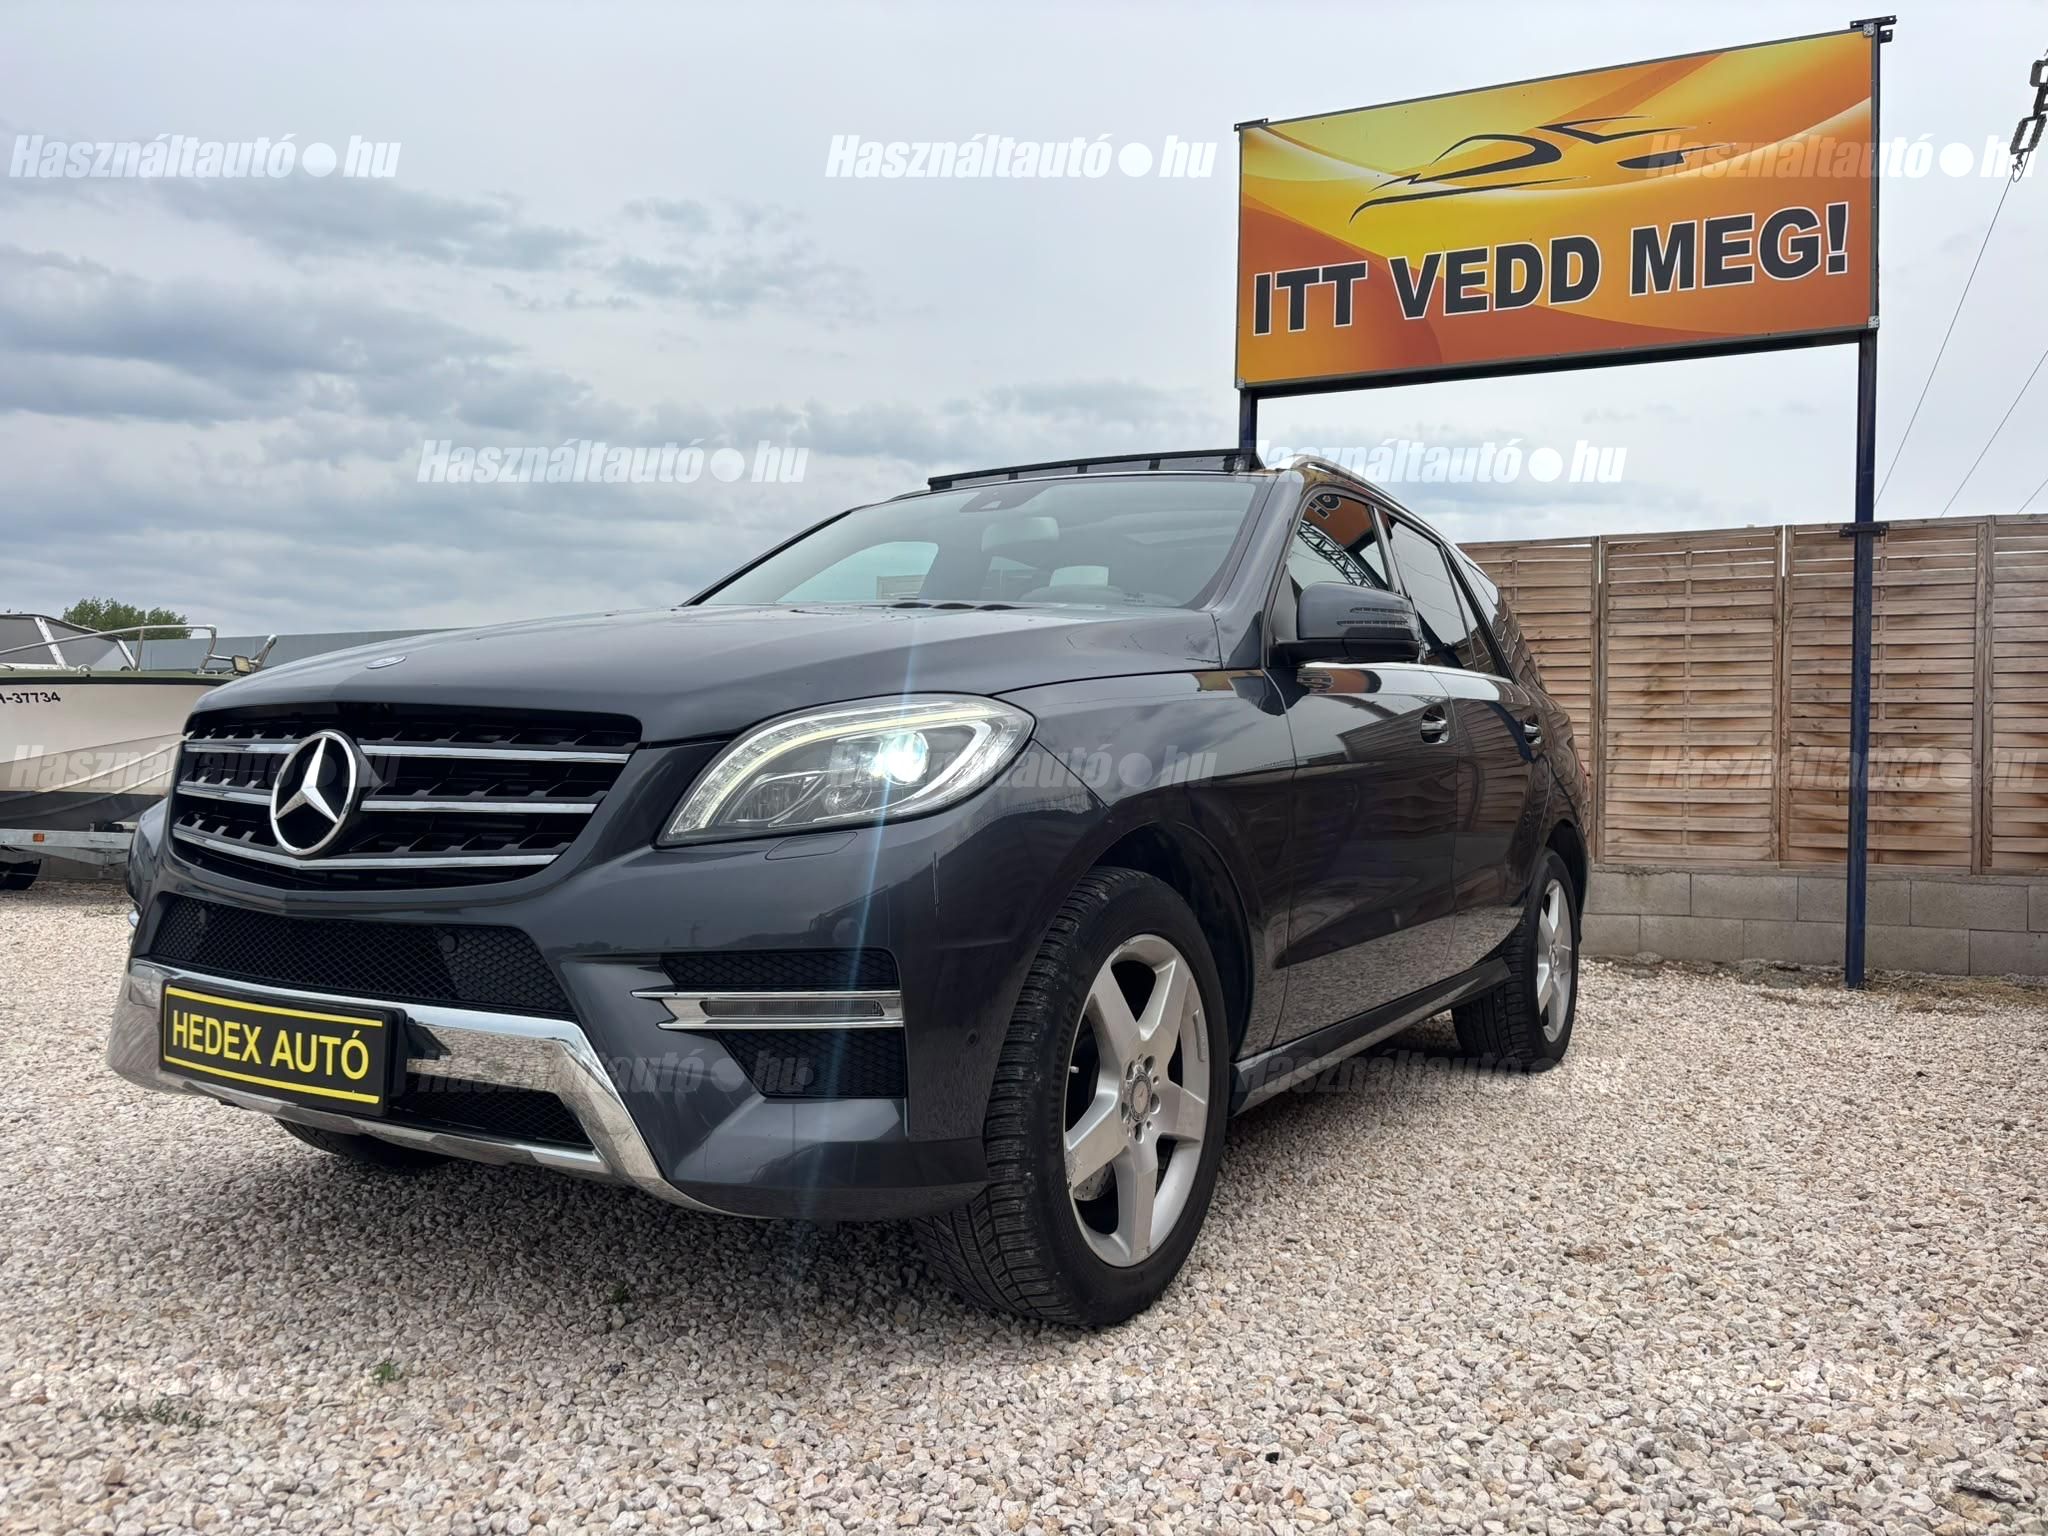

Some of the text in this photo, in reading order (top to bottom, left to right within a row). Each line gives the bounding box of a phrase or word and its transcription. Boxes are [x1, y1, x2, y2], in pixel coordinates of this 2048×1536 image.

[1253, 201, 1849, 336] ITT VEDD MEG!
[172, 1010, 369, 1080] HEDEX AUTÓ
